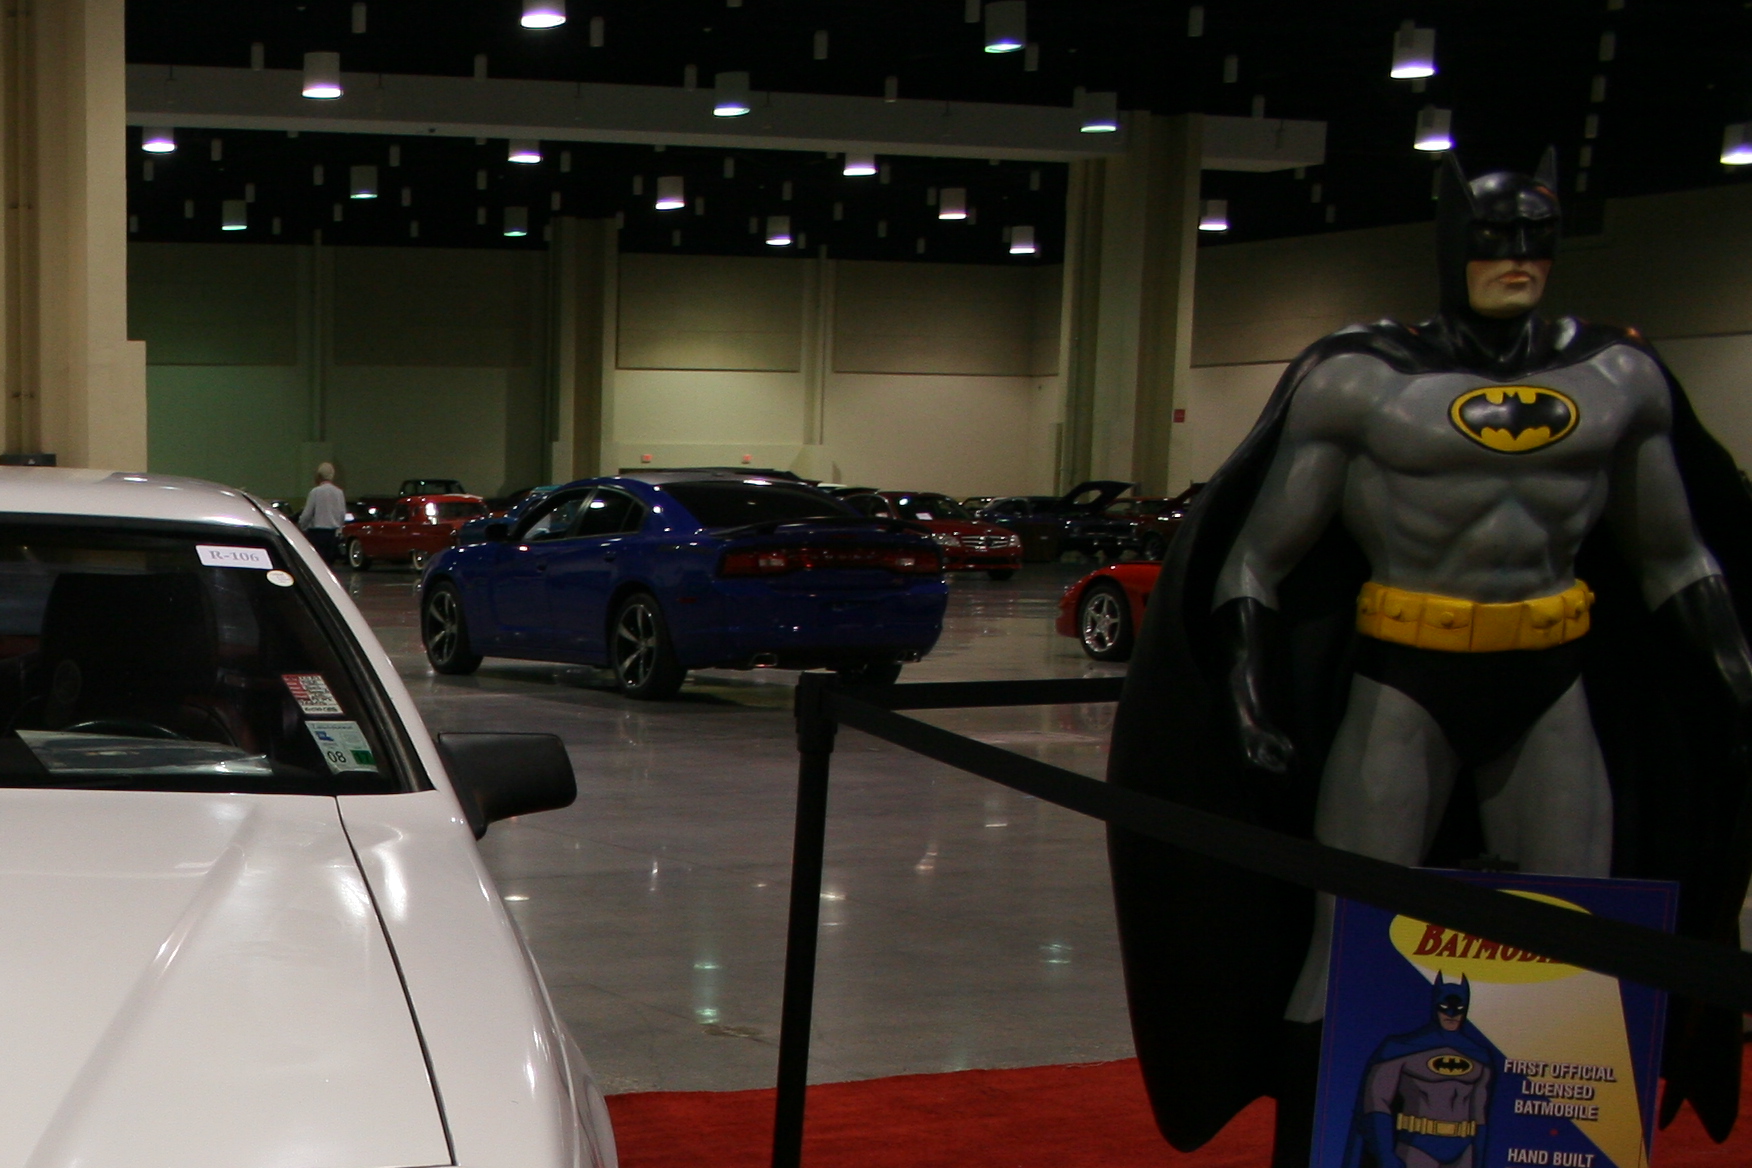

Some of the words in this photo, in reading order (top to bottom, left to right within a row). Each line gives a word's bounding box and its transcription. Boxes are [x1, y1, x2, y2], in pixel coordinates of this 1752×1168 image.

[209, 550, 259, 562] R-106
[327, 751, 346, 763] 08
[1504, 1058, 1547, 1078] FIRST
[1550, 1062, 1616, 1081] OFFICIAL
[1521, 1080, 1594, 1100] LICENSED
[1514, 1099, 1598, 1120] BATMOBILE
[1507, 1148, 1548, 1165] HAND
[1552, 1151, 1594, 1168] BUILT
